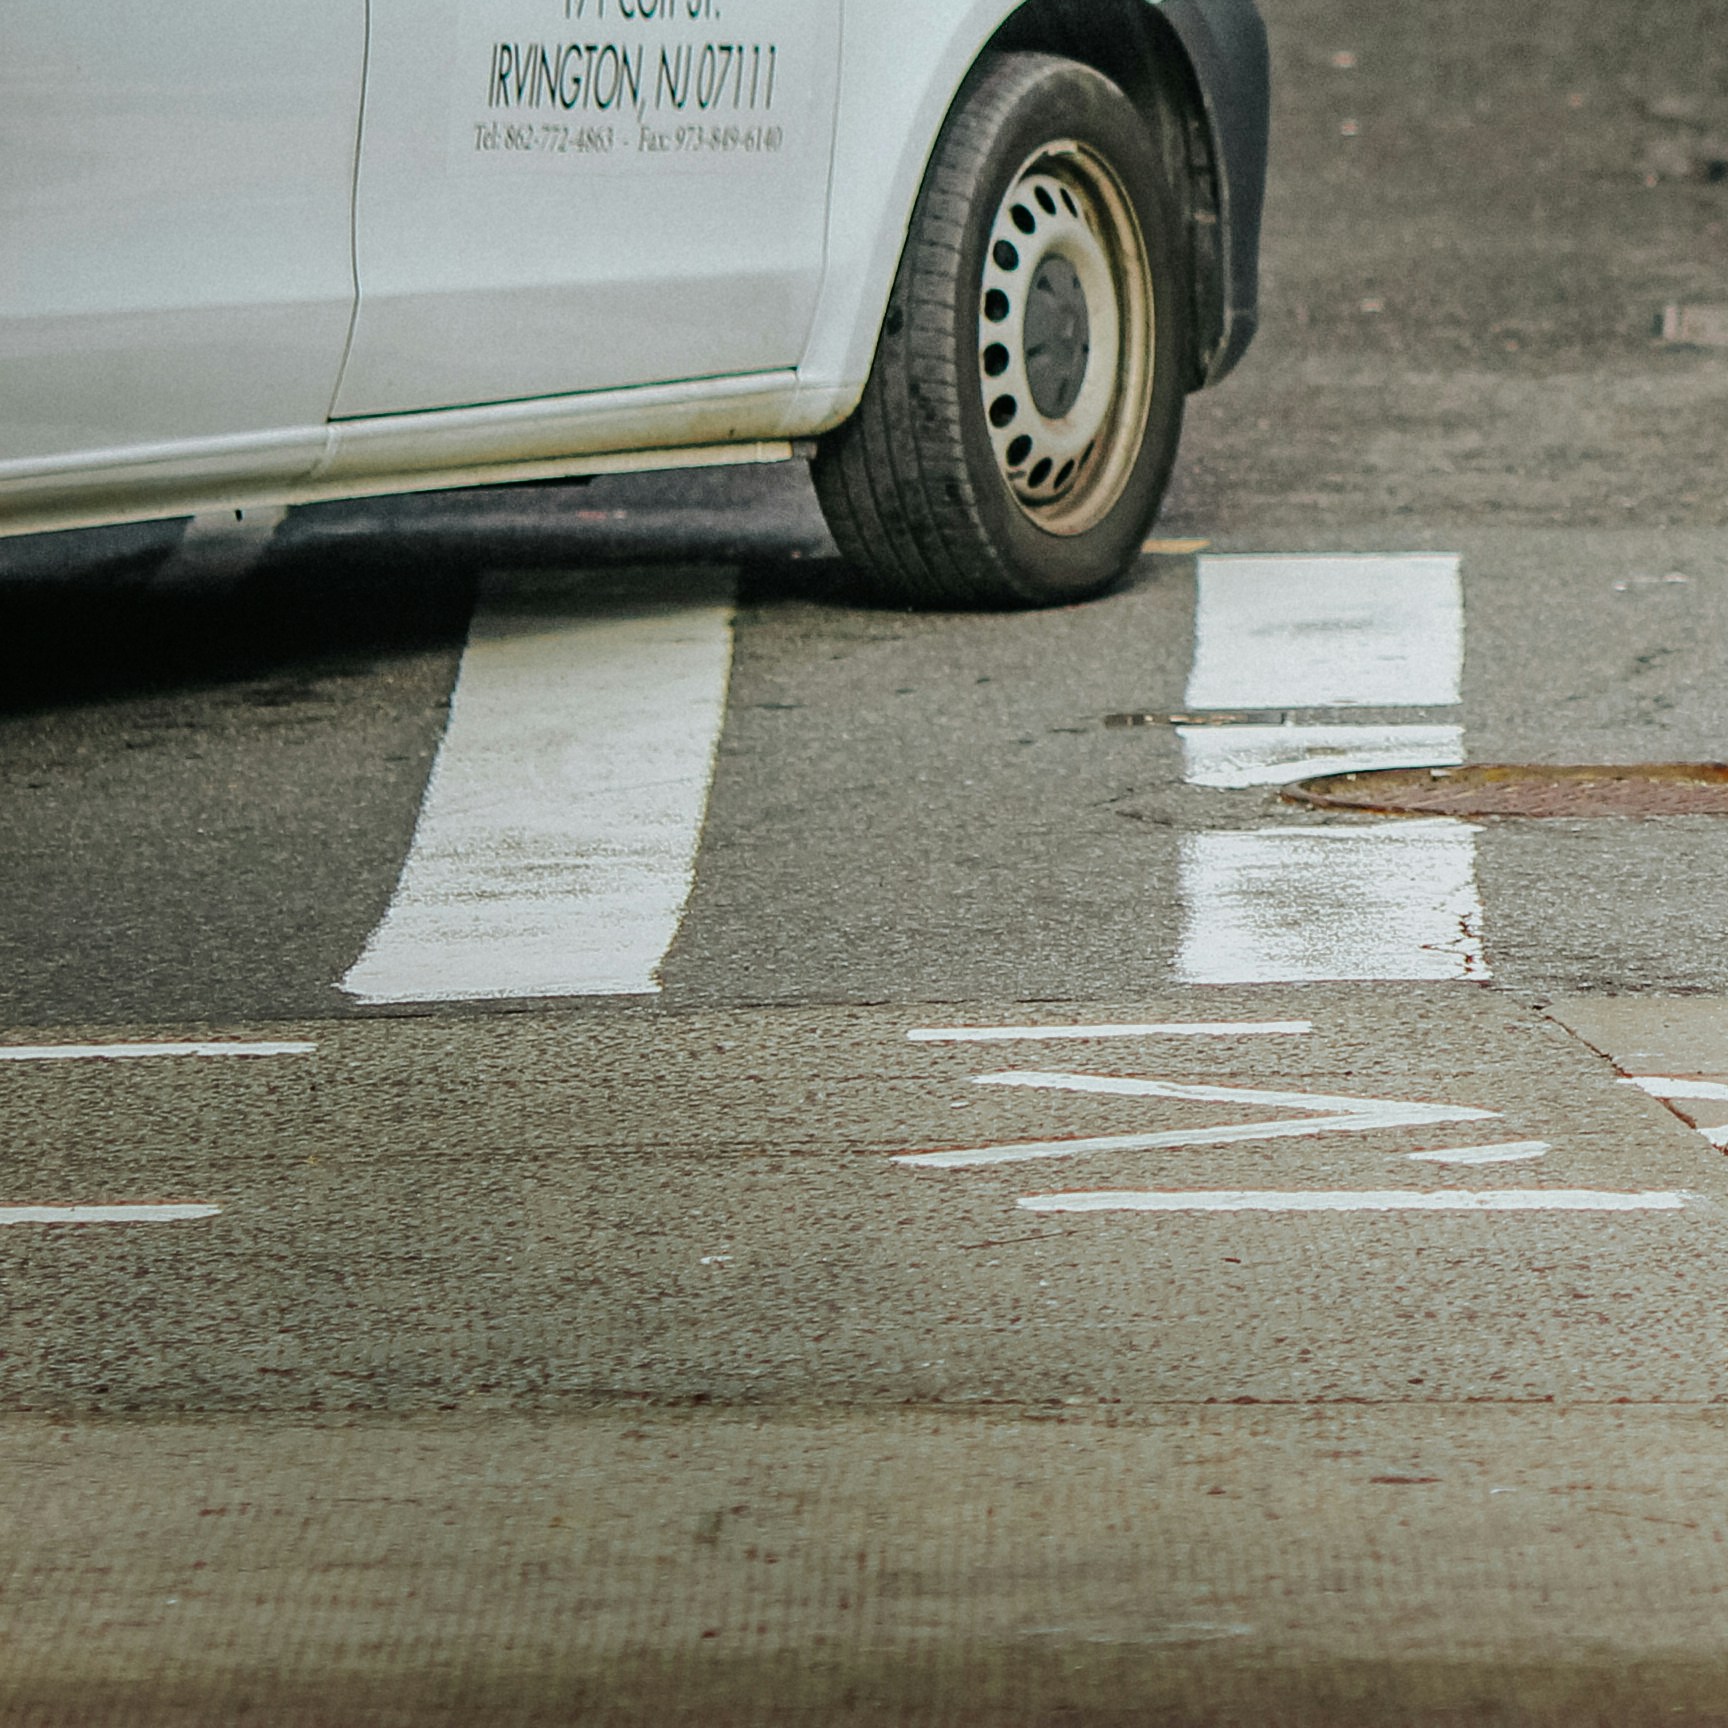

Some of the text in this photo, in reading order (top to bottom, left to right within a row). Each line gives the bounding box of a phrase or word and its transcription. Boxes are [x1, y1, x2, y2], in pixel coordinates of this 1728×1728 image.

[489, 43, 776, 122] IRVINGTON, NJ 07111
